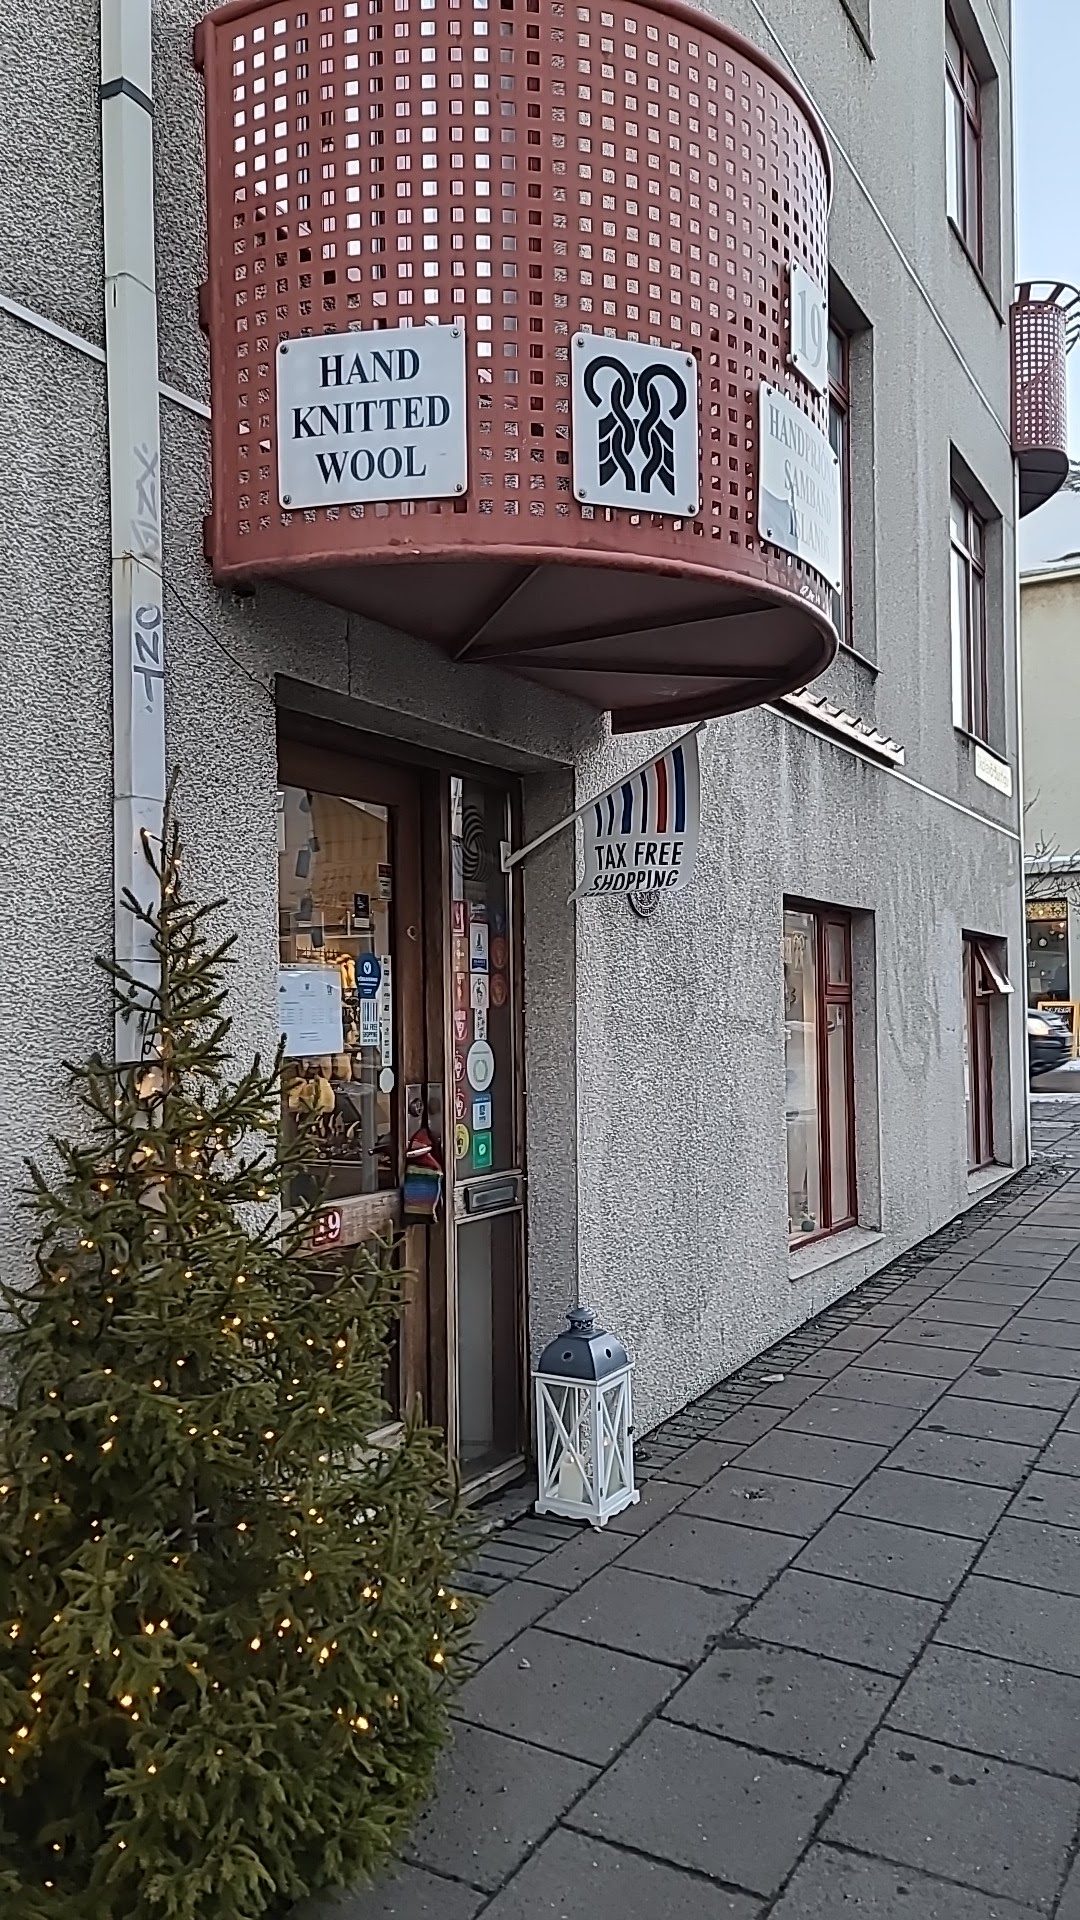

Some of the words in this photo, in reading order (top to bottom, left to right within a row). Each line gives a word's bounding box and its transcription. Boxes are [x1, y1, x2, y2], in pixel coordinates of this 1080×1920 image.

[798, 290, 822, 367] 19
[319, 348, 420, 387] HAND
[292, 395, 450, 439] KNITTED
[315, 445, 427, 484] WOOL
[595, 842, 627, 870] TAX
[634, 841, 684, 866] FREE
[588, 869, 680, 892] SHOPPING
